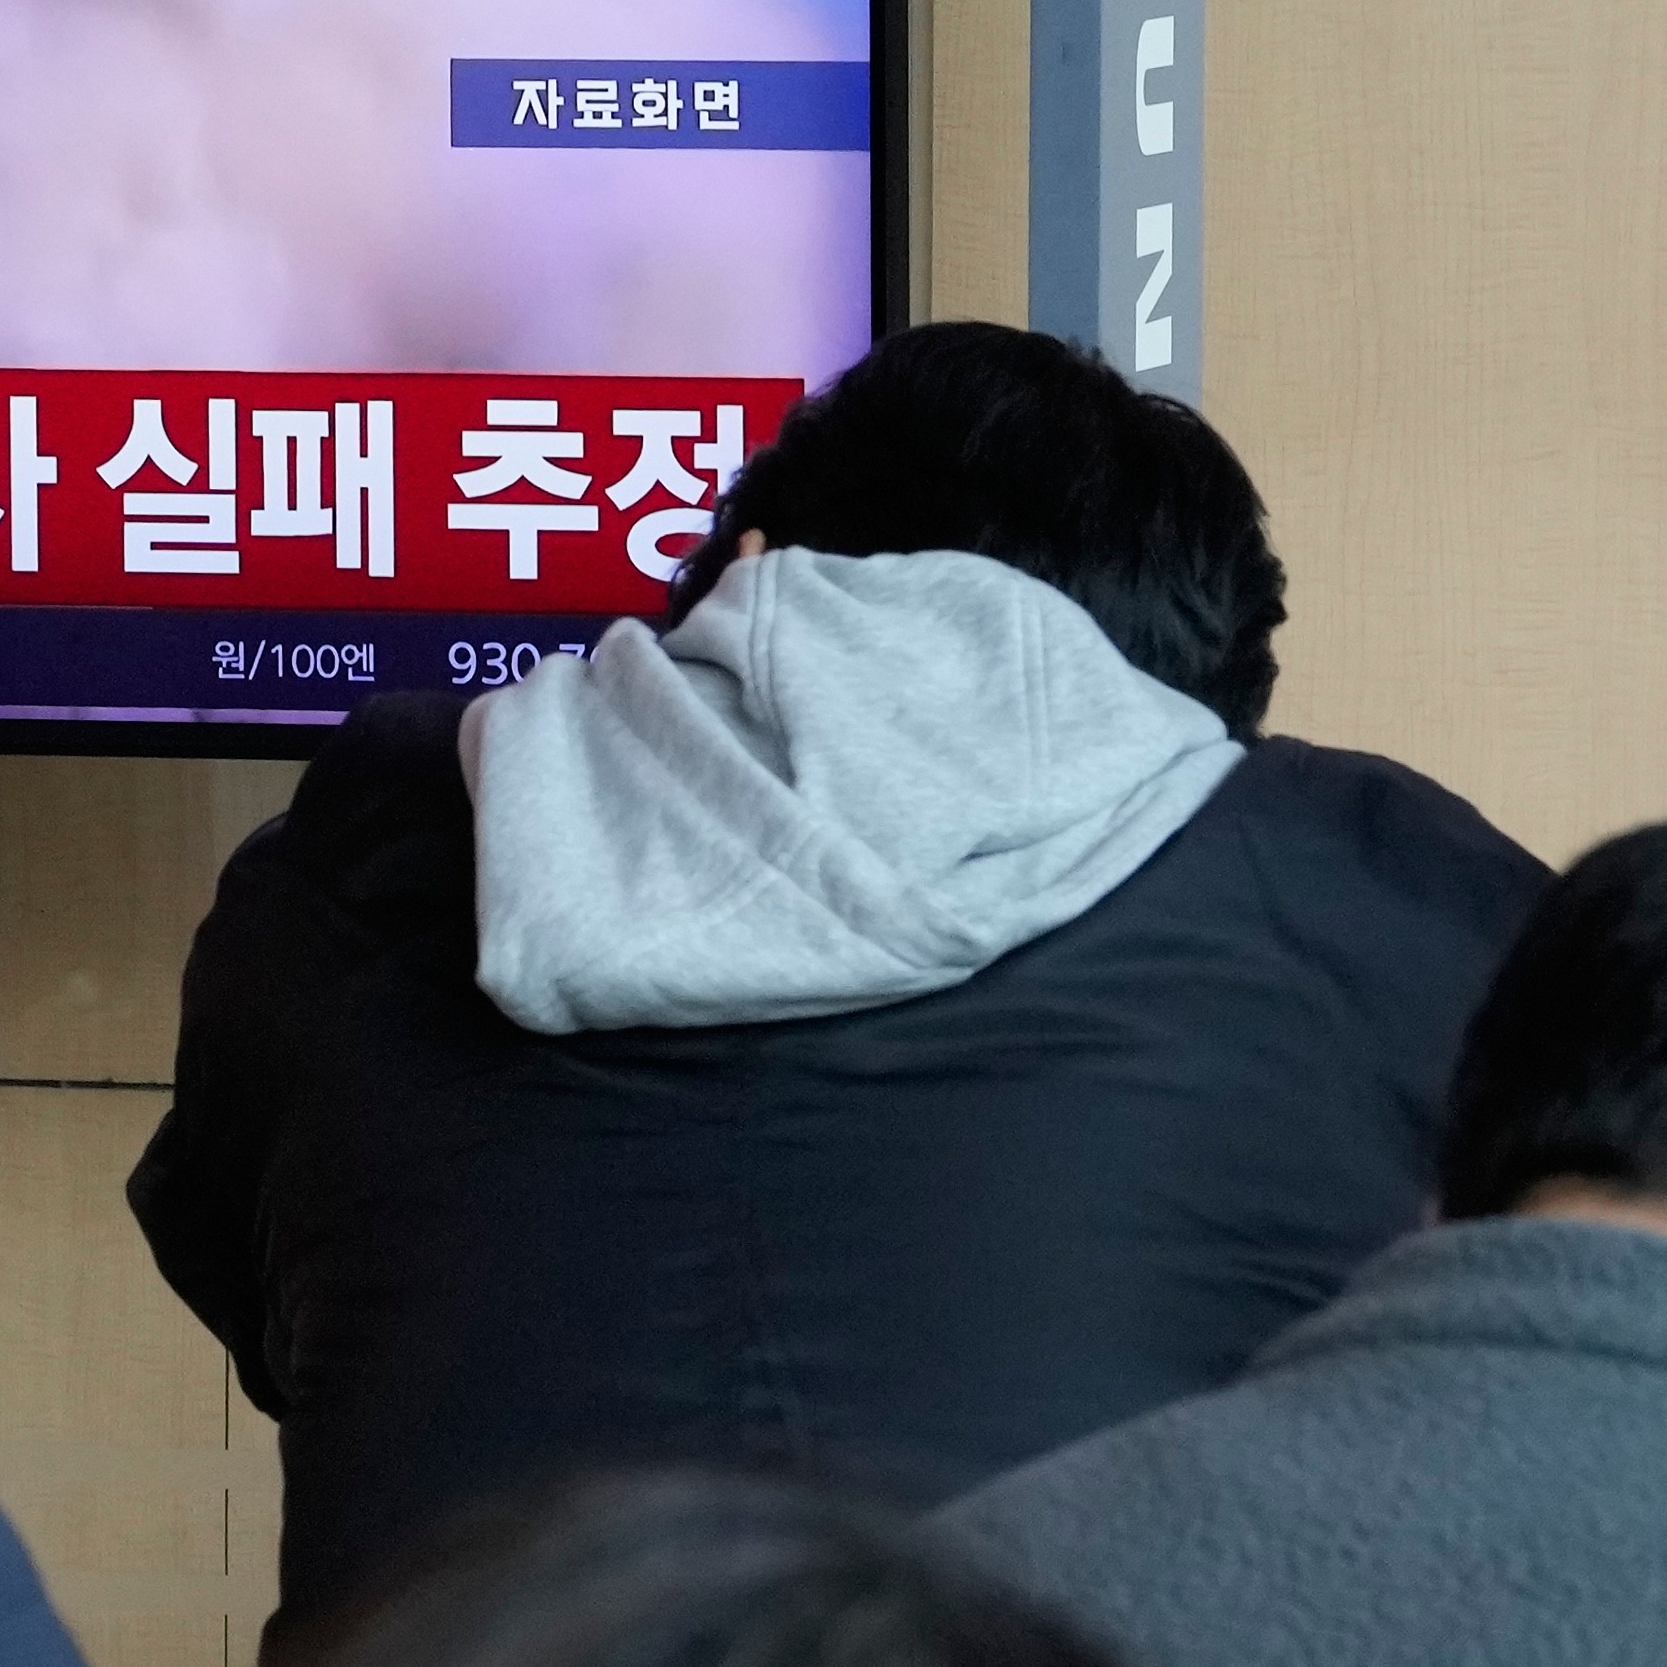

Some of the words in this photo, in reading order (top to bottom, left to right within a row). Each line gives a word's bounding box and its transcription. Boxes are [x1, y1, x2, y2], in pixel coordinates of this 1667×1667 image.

[511, 78, 741, 131] 자료화면
[96, 397, 397, 580] 실패
[446, 398, 745, 583] 추정
[211, 639, 376, 682] 원/100엔
